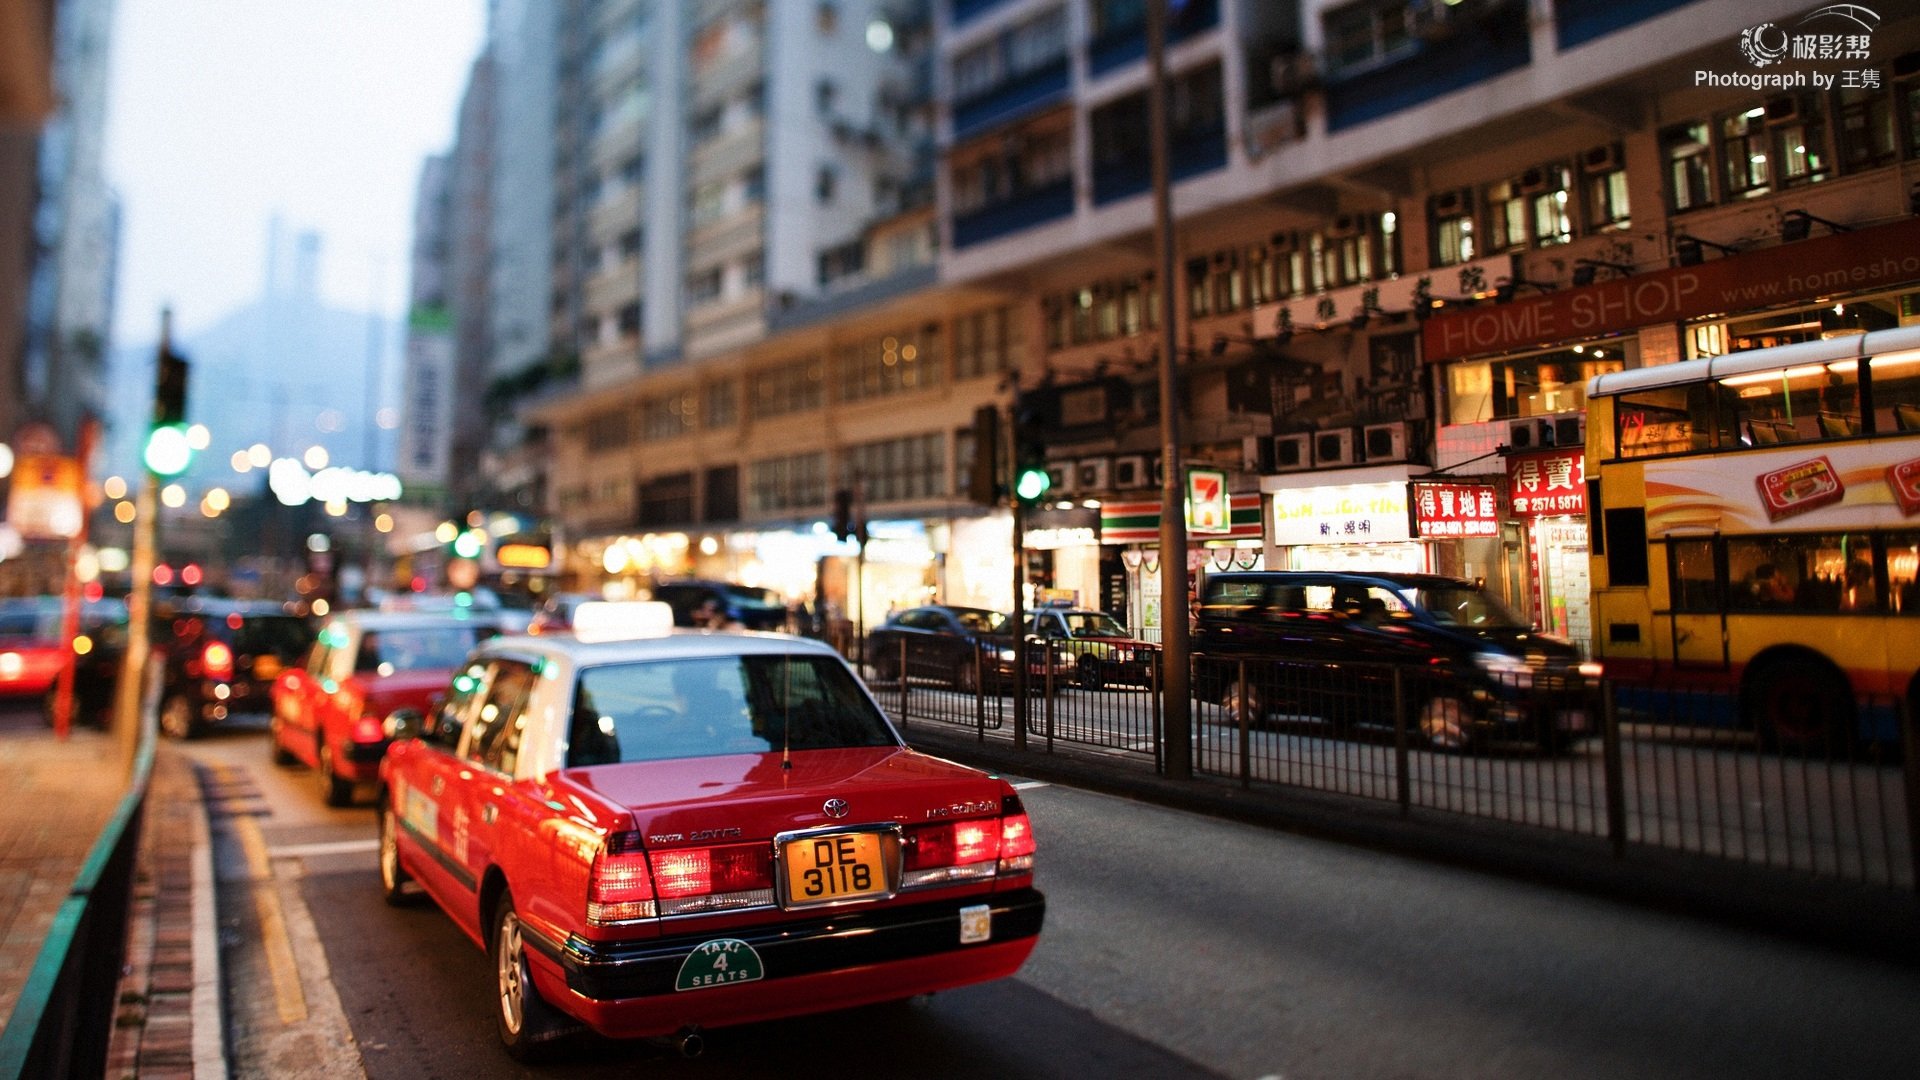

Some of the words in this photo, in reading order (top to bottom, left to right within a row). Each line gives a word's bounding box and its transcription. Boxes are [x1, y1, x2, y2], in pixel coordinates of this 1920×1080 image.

[1443, 300, 1555, 351] HOME
[1571, 273, 1700, 329] SHOP
[1531, 497, 1556, 512] 2574
[1558, 494, 1583, 510] 5871
[649, 833, 684, 843] TOYOTA
[814, 838, 856, 868] DE
[804, 863, 871, 896] 3118
[701, 941, 740, 956] TAXI
[713, 952, 728, 971] 4
[692, 969, 748, 986] SEATS
